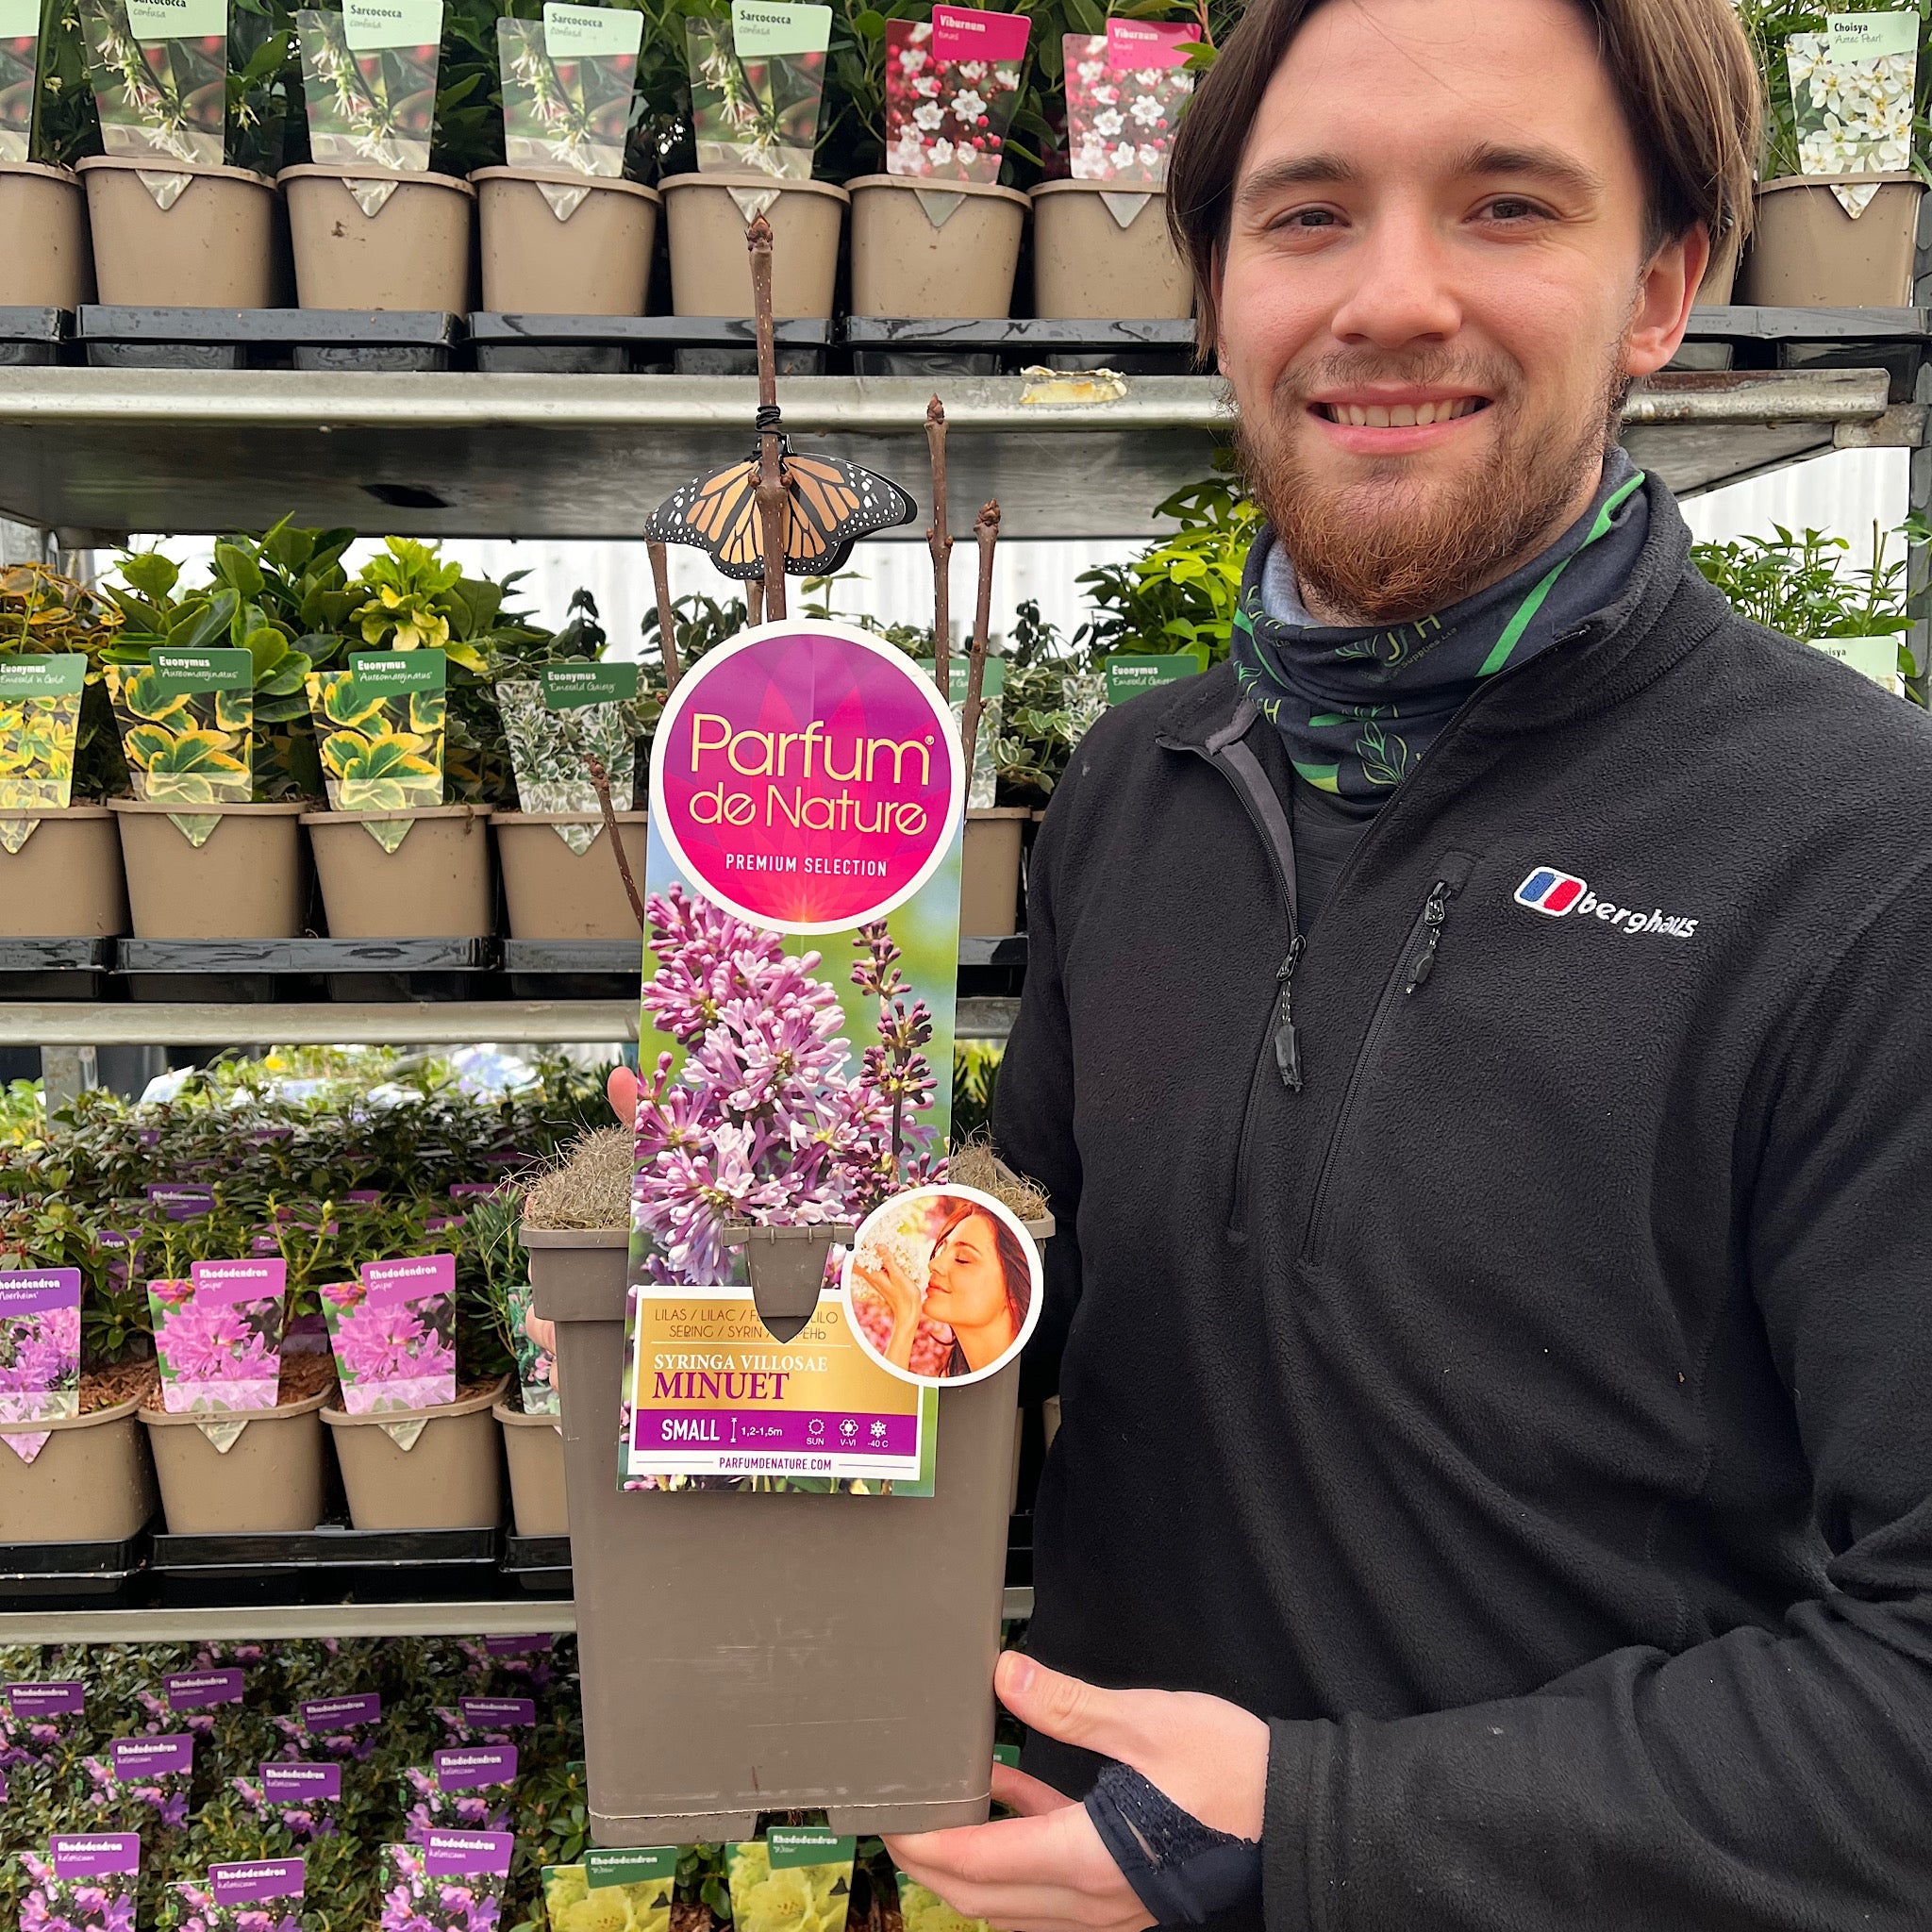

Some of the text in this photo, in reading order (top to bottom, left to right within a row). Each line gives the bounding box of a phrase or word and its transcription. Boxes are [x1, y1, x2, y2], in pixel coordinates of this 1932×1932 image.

[350, 4, 402, 18] Sarcococca
[740, 9, 791, 25] Sarcococca
[551, 12, 603, 27] Sarcococca
[939, 14, 986, 32] Viburnum
[1114, 27, 1158, 41] Viburnum
[1834, 22, 1868, 34] Choisya
[1, 663, 46, 675] Euonymus
[158, 656, 210, 669] Euonymus
[358, 659, 407, 673] Euonymus
[547, 671, 596, 683] Euonymus
[1111, 665, 1158, 677] Euonymus
[689, 782, 927, 836] de Nature
[725, 854, 887, 877] PREMIUM SELECTION
[1577, 891, 1699, 938] berghaus
[199, 1268, 268, 1279] Rhododendron
[370, 1265, 437, 1280] Rhododendron
[655, 1308, 687, 1321] LILAS
[701, 1309, 737, 1322] LILAC
[669, 1325, 714, 1338] SERING
[727, 1326, 762, 1339] SYRIN
[654, 1354, 828, 1373] SYRINGA VILLOSAE
[652, 1372, 790, 1400] MINUET
[661, 1419, 783, 1441] SMALL 1,2-1,5m
[807, 1437, 824, 1445] SUN
[719, 1457, 831, 1471] PARFUMDENATURE.COM
[117, 1743, 177, 1755] Rhododendron
[441, 1755, 502, 1766] Rhododendron
[266, 1769, 325, 1779] Rhododendron
[58, 1841, 123, 1852] Rhododendron
[430, 1836, 496, 1851] Rhododendron
[773, 1835, 838, 1845] Rhododendron
[591, 1855, 658, 1865] Rhododendron
[217, 1868, 286, 1880] Rhododendron
